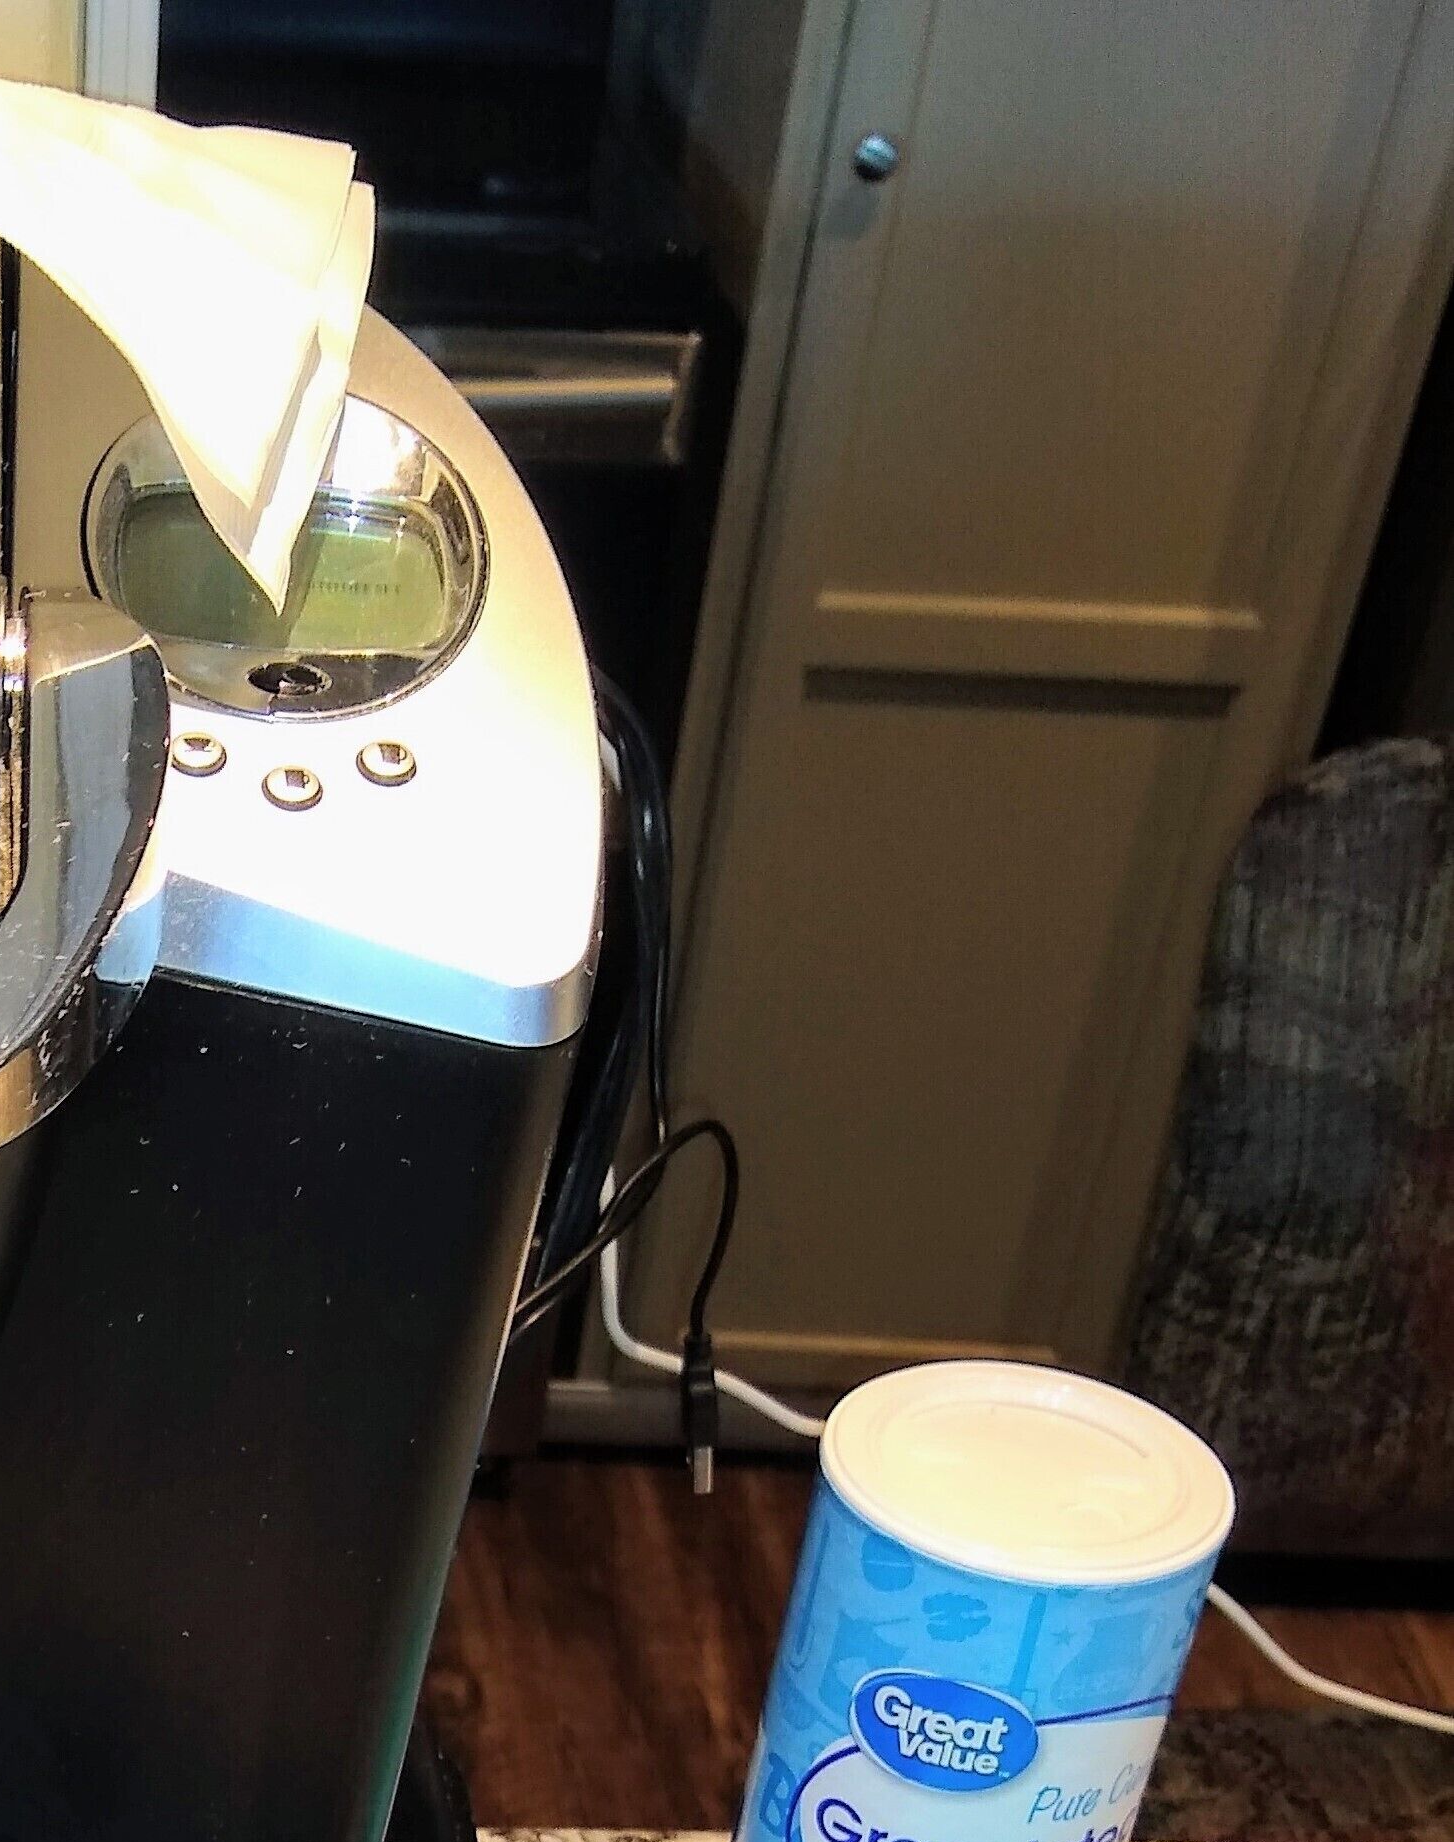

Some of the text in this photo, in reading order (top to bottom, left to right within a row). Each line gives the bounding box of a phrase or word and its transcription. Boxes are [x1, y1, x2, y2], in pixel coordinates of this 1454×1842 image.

[873, 1684, 1008, 1752] Great
[897, 1729, 1000, 1776] Value
[1027, 1785, 1099, 1824] Pure
